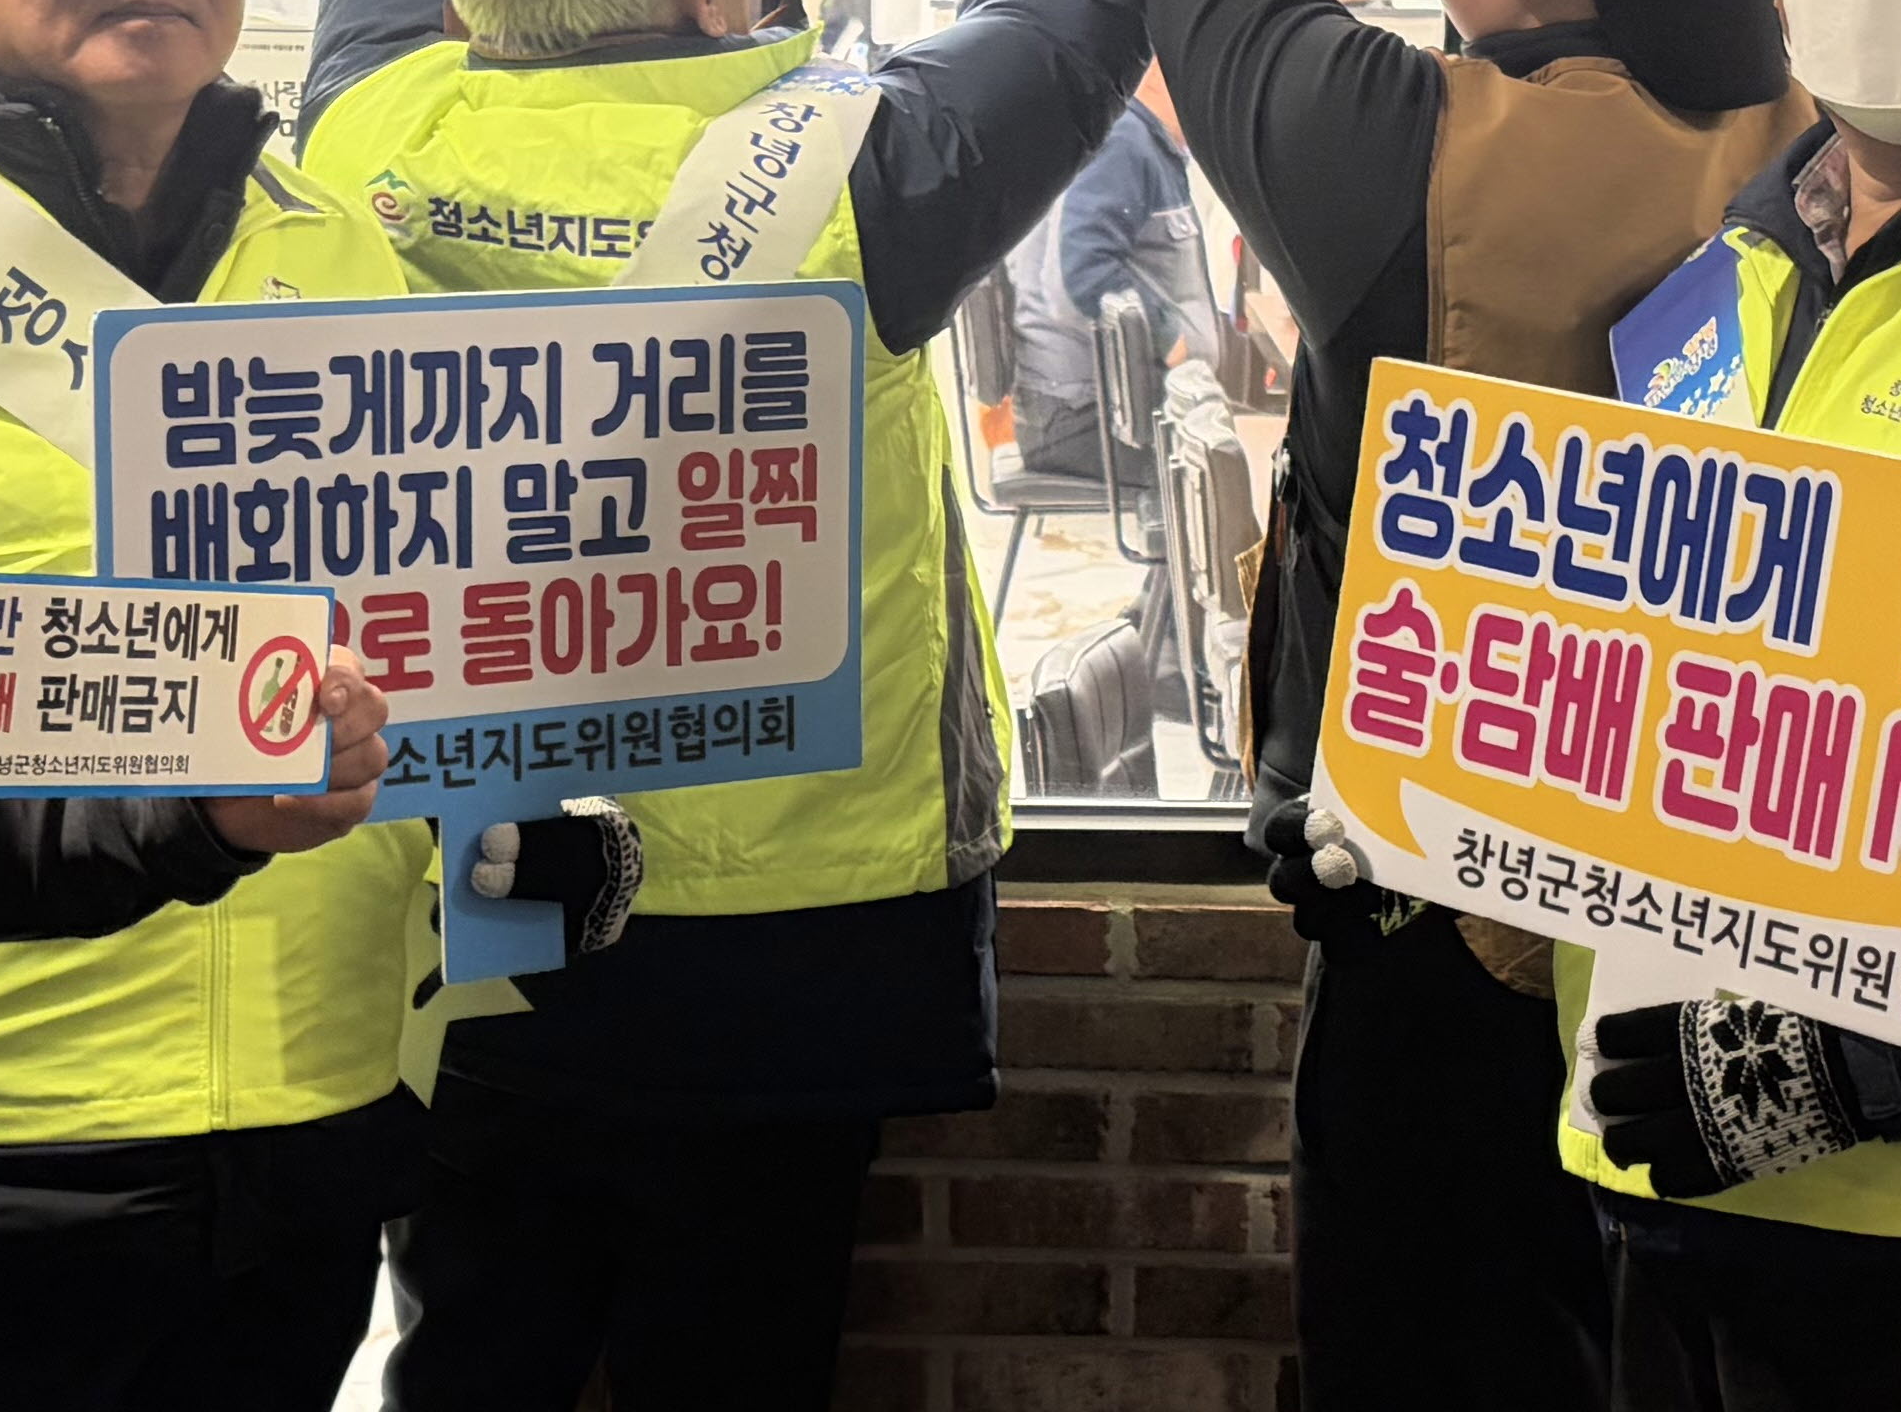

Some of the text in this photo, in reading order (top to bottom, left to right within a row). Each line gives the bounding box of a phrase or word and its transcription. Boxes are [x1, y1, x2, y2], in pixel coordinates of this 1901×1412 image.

[161, 331, 809, 469] 밤늦게까지 거리를
[151, 443, 818, 581] 배회하지 말고 일찍
[1383, 398, 1834, 646] 청소년에게
[40, 598, 240, 664] 청소년에게
[334, 559, 783, 693] 로 돌아가요!
[37, 673, 197, 736] 판매금지
[1663, 661, 1857, 860] 판매
